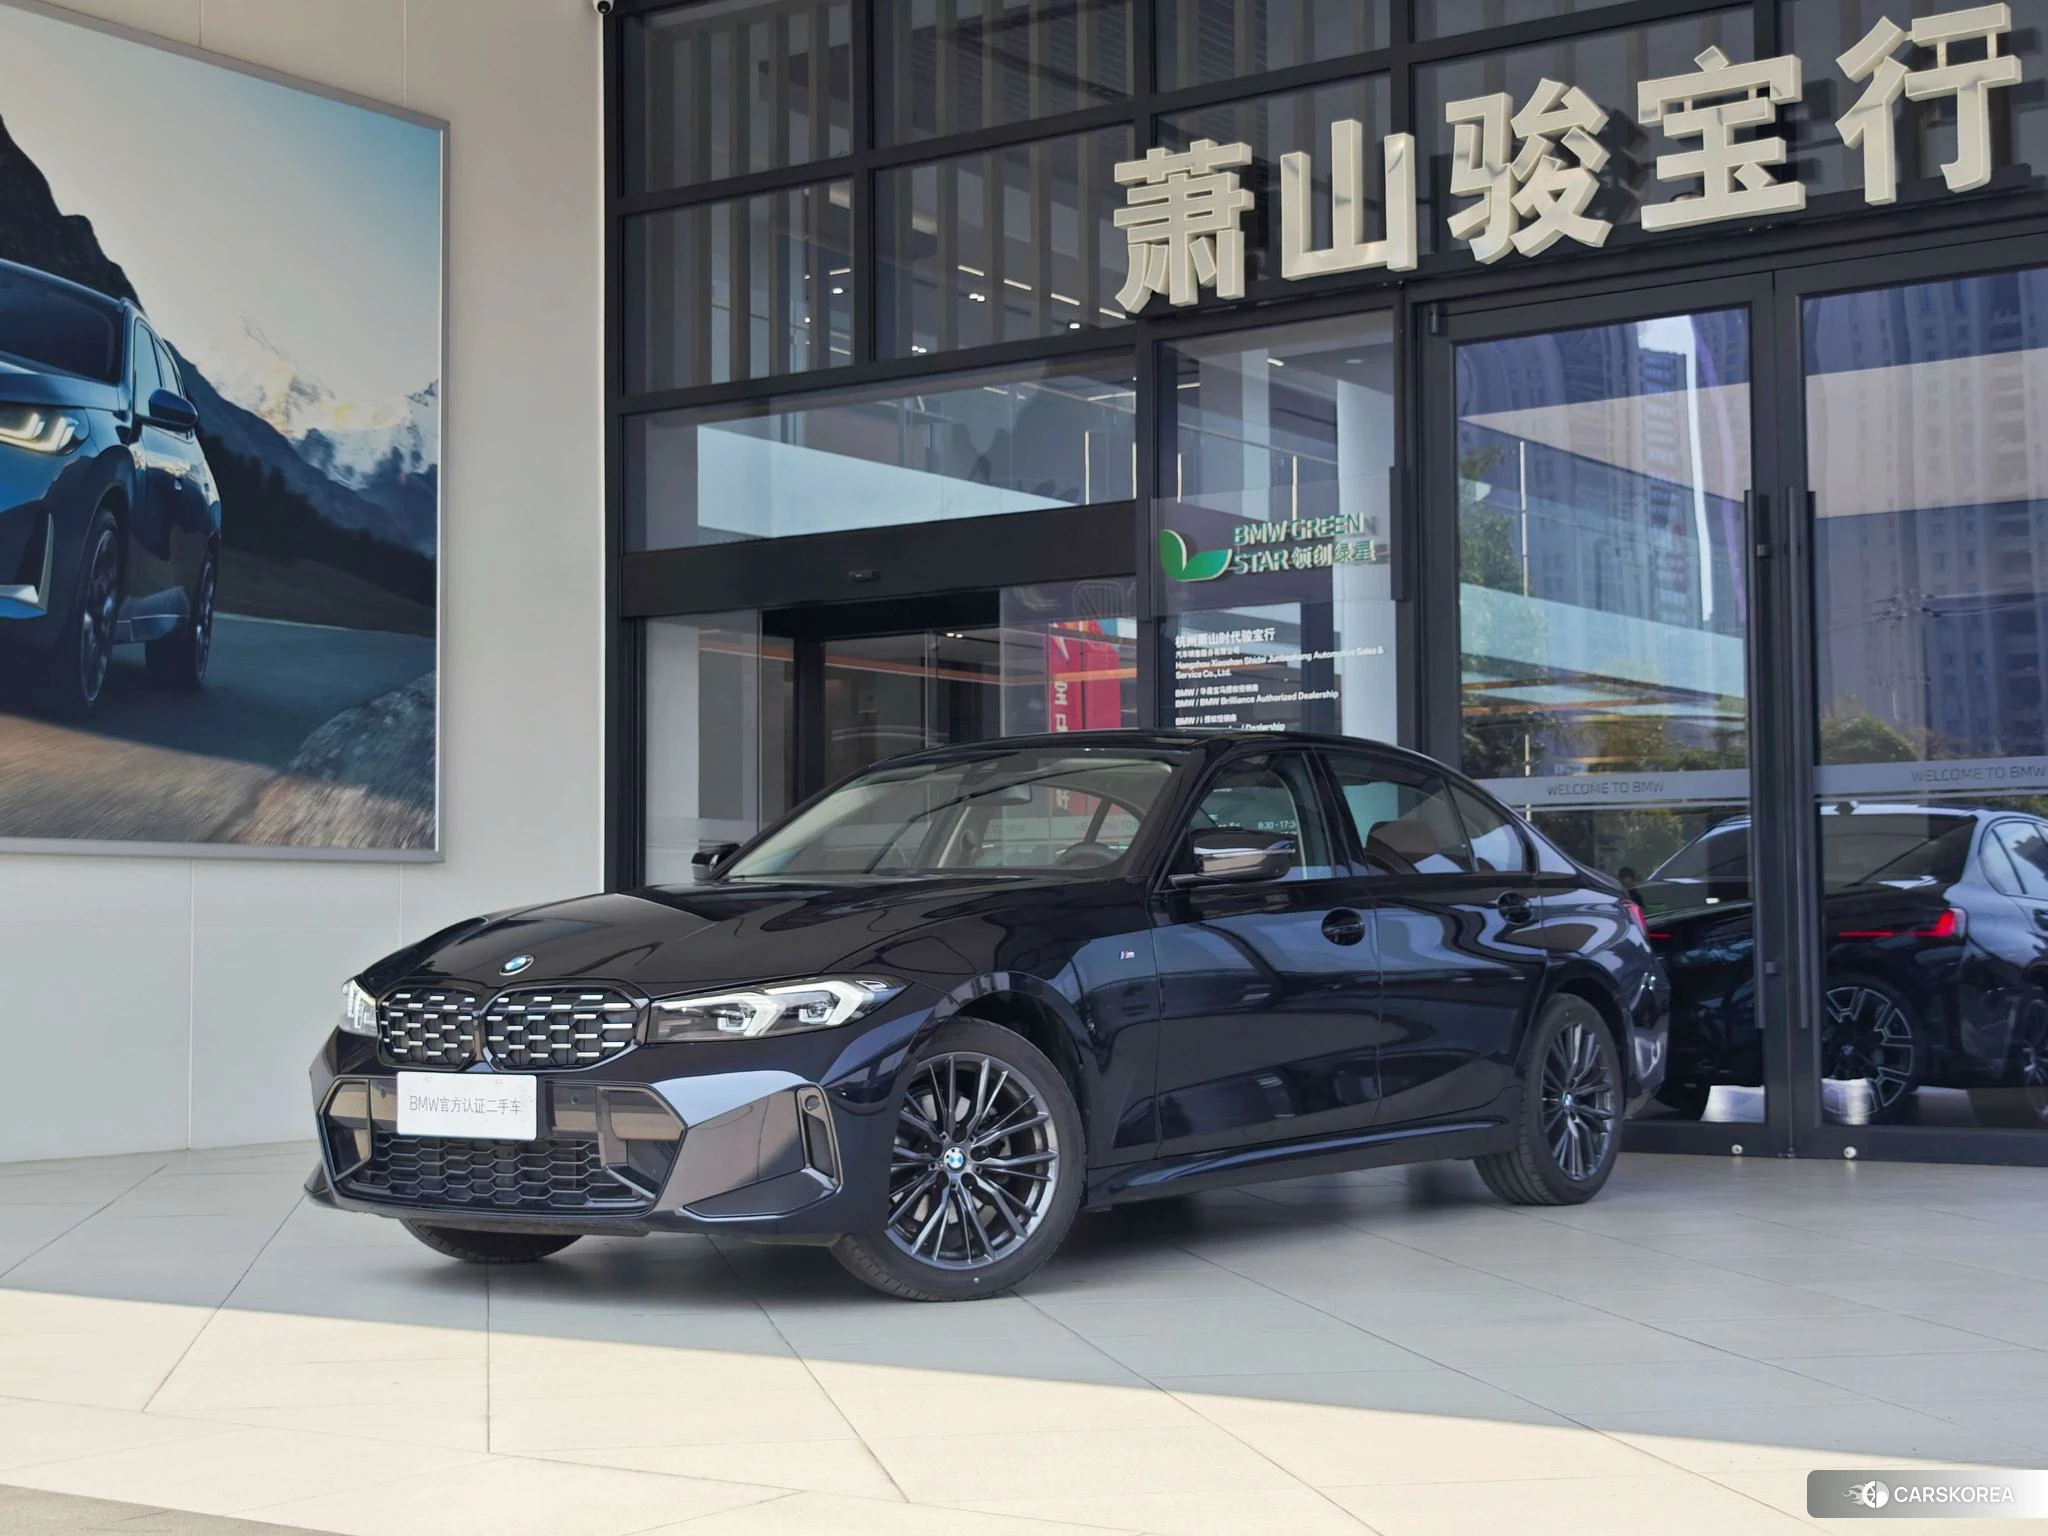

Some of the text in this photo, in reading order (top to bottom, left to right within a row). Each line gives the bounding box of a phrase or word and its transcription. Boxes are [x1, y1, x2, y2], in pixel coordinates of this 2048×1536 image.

[1113, 3, 2022, 313] 萧山骏宝行
[1235, 512, 1365, 545] BMW GREEN
[1234, 539, 1377, 574] STAR 领创绿星
[1175, 671, 1202, 680] Service
[1175, 688, 1195, 698] BMW
[1175, 698, 1195, 708] BMW
[1200, 697, 1220, 707] BMW
[1220, 695, 1255, 705] Brilliance
[1256, 692, 1297, 703] Authorized
[1298, 690, 1339, 700] Dealership
[1175, 716, 1196, 726] BMW
[1911, 764, 2046, 782] WELCOME TO BMW
[1546, 780, 1665, 796] WELCOME TO BMW
[409, 1095, 522, 1115] BMW官方认证二手车
